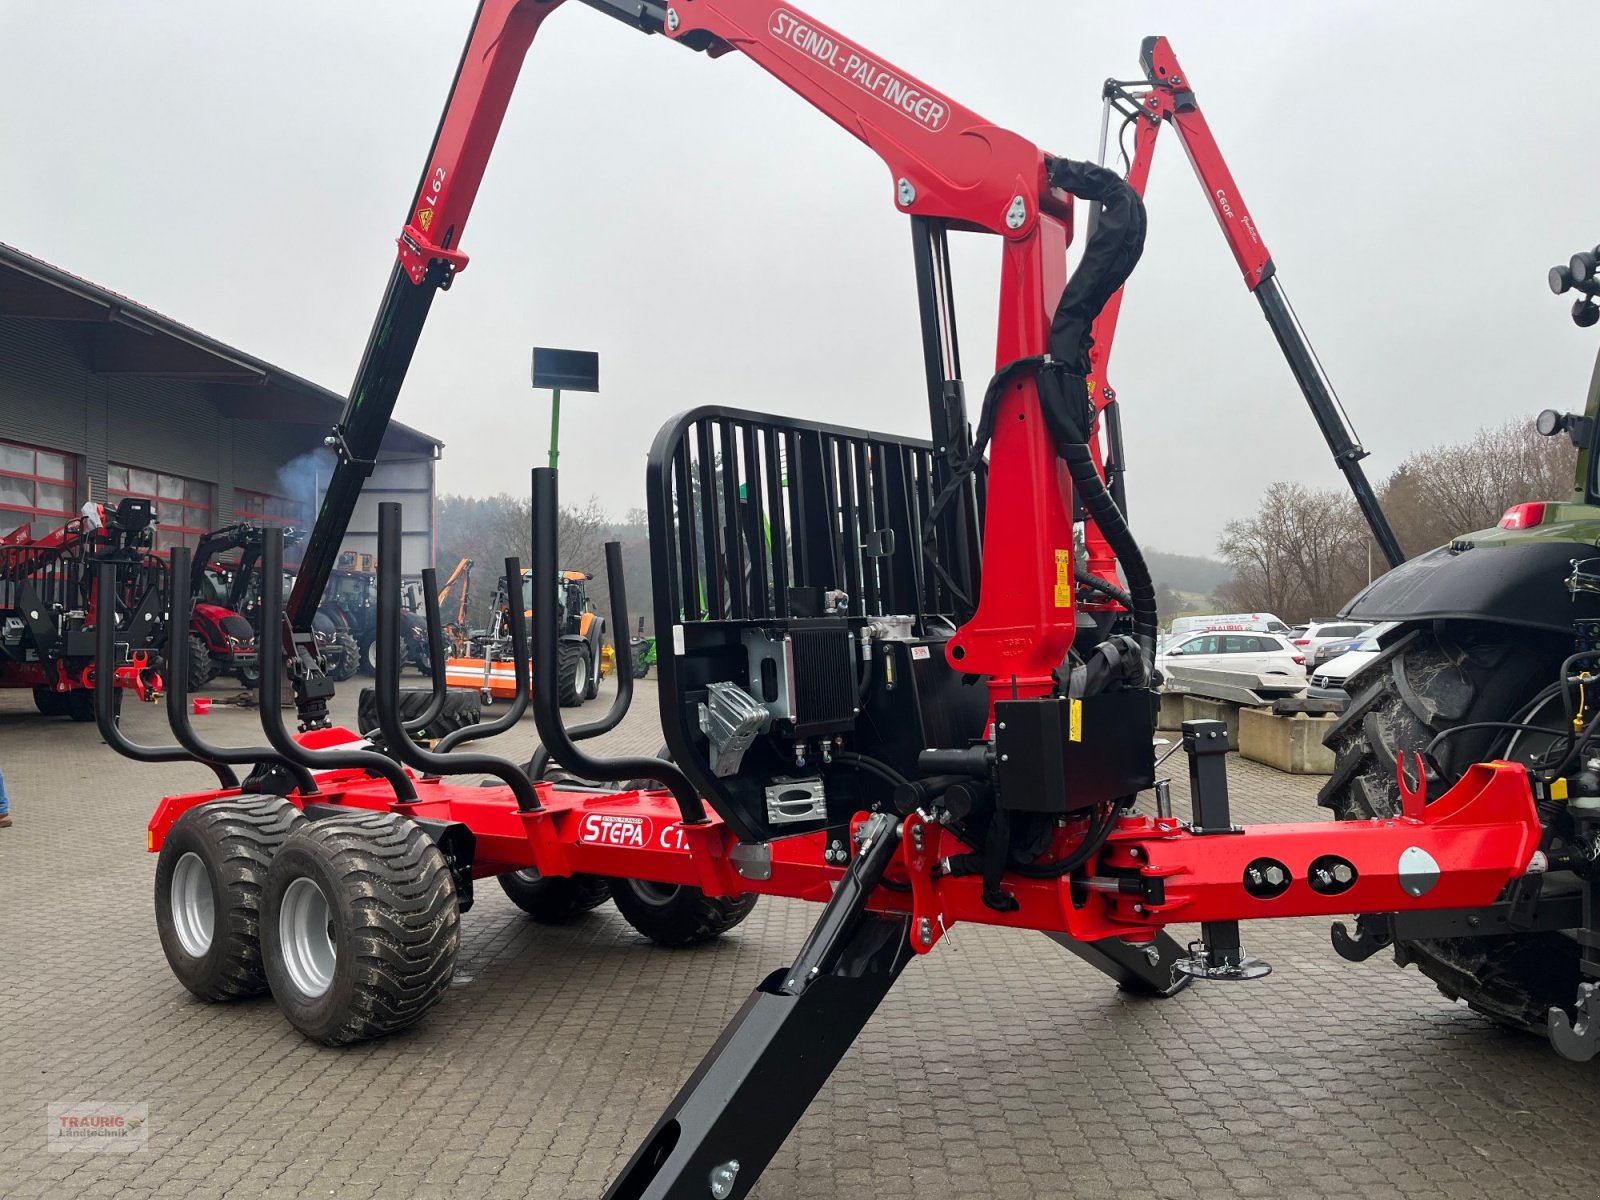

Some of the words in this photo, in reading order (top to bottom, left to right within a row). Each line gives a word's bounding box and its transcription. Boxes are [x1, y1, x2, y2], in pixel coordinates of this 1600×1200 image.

[772, 12, 945, 128] STEINDL-PALFINGER
[583, 815, 643, 846] STEPA
[659, 826, 691, 850] C1
